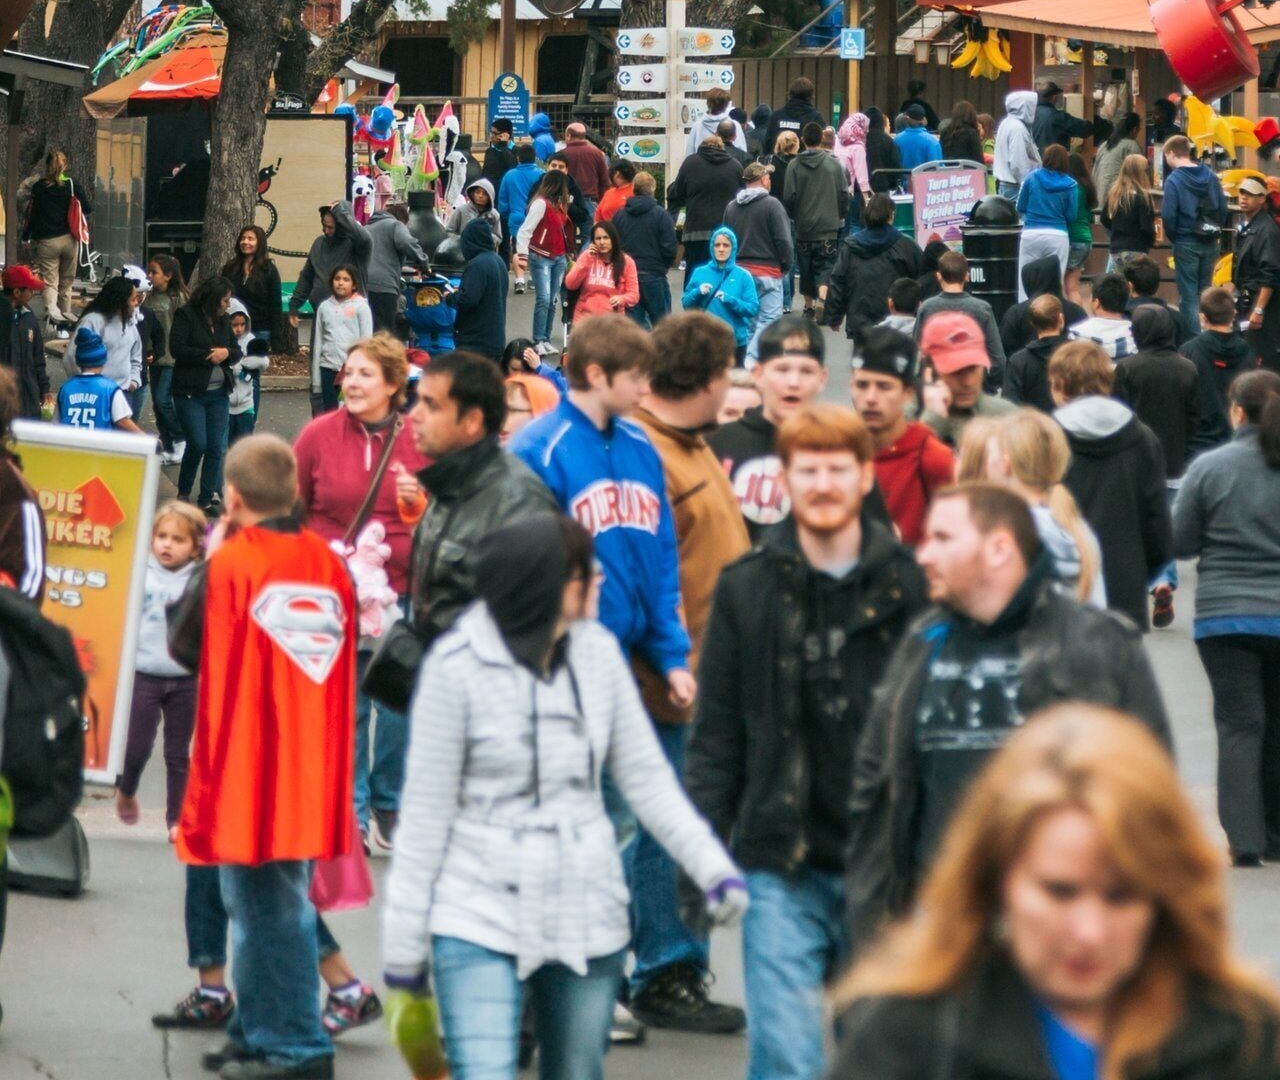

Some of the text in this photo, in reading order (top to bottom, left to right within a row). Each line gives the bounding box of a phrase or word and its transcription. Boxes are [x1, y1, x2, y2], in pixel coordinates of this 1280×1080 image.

[928, 174, 972, 192] Turn Your
[926, 186, 975, 206] Taste Buds
[922, 200, 977, 222] Upside Dow
[970, 267, 986, 283] OIL
[68, 392, 99, 405] DURANT
[67, 407, 97, 430] 35
[37, 488, 84, 515] DIE
[44, 566, 108, 589] NGS
